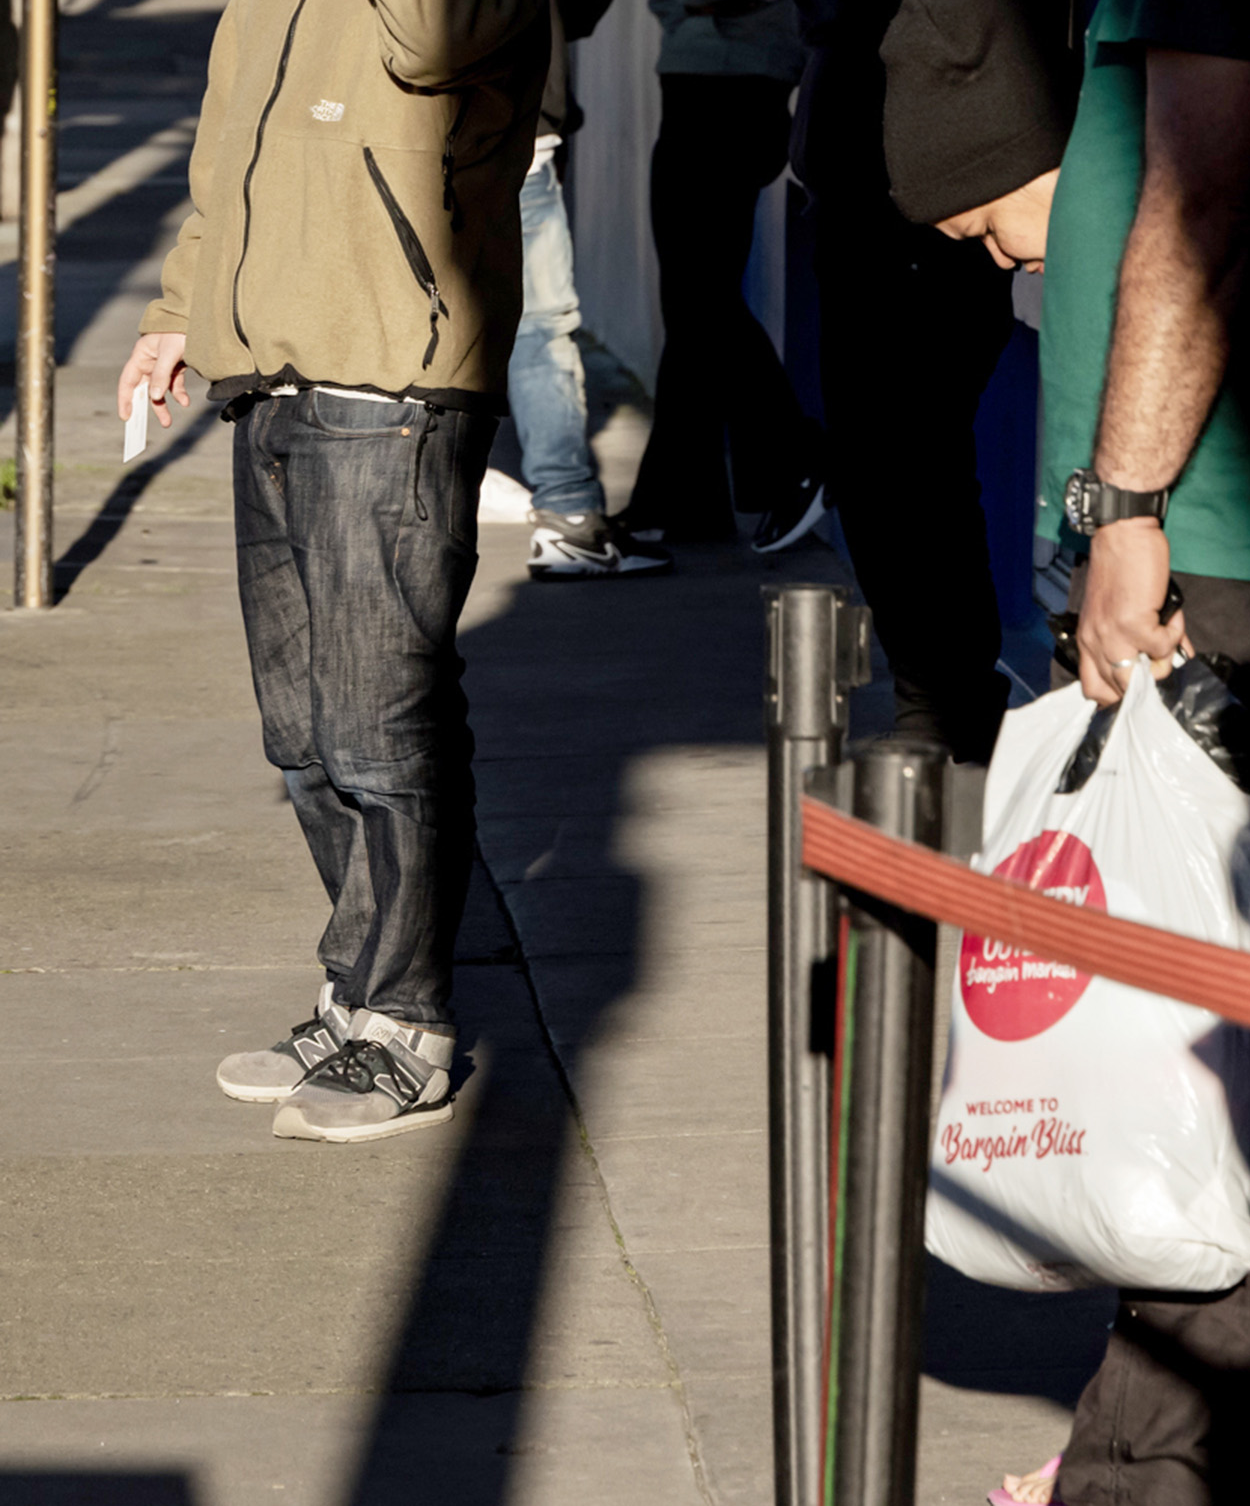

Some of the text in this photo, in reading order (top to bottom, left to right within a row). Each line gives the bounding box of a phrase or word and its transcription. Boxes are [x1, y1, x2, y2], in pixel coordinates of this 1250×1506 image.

[293, 1028, 340, 1070] N
[965, 1097, 1059, 1116] WELCOME TO
[940, 1117, 1087, 1173] Bargain Bliss
